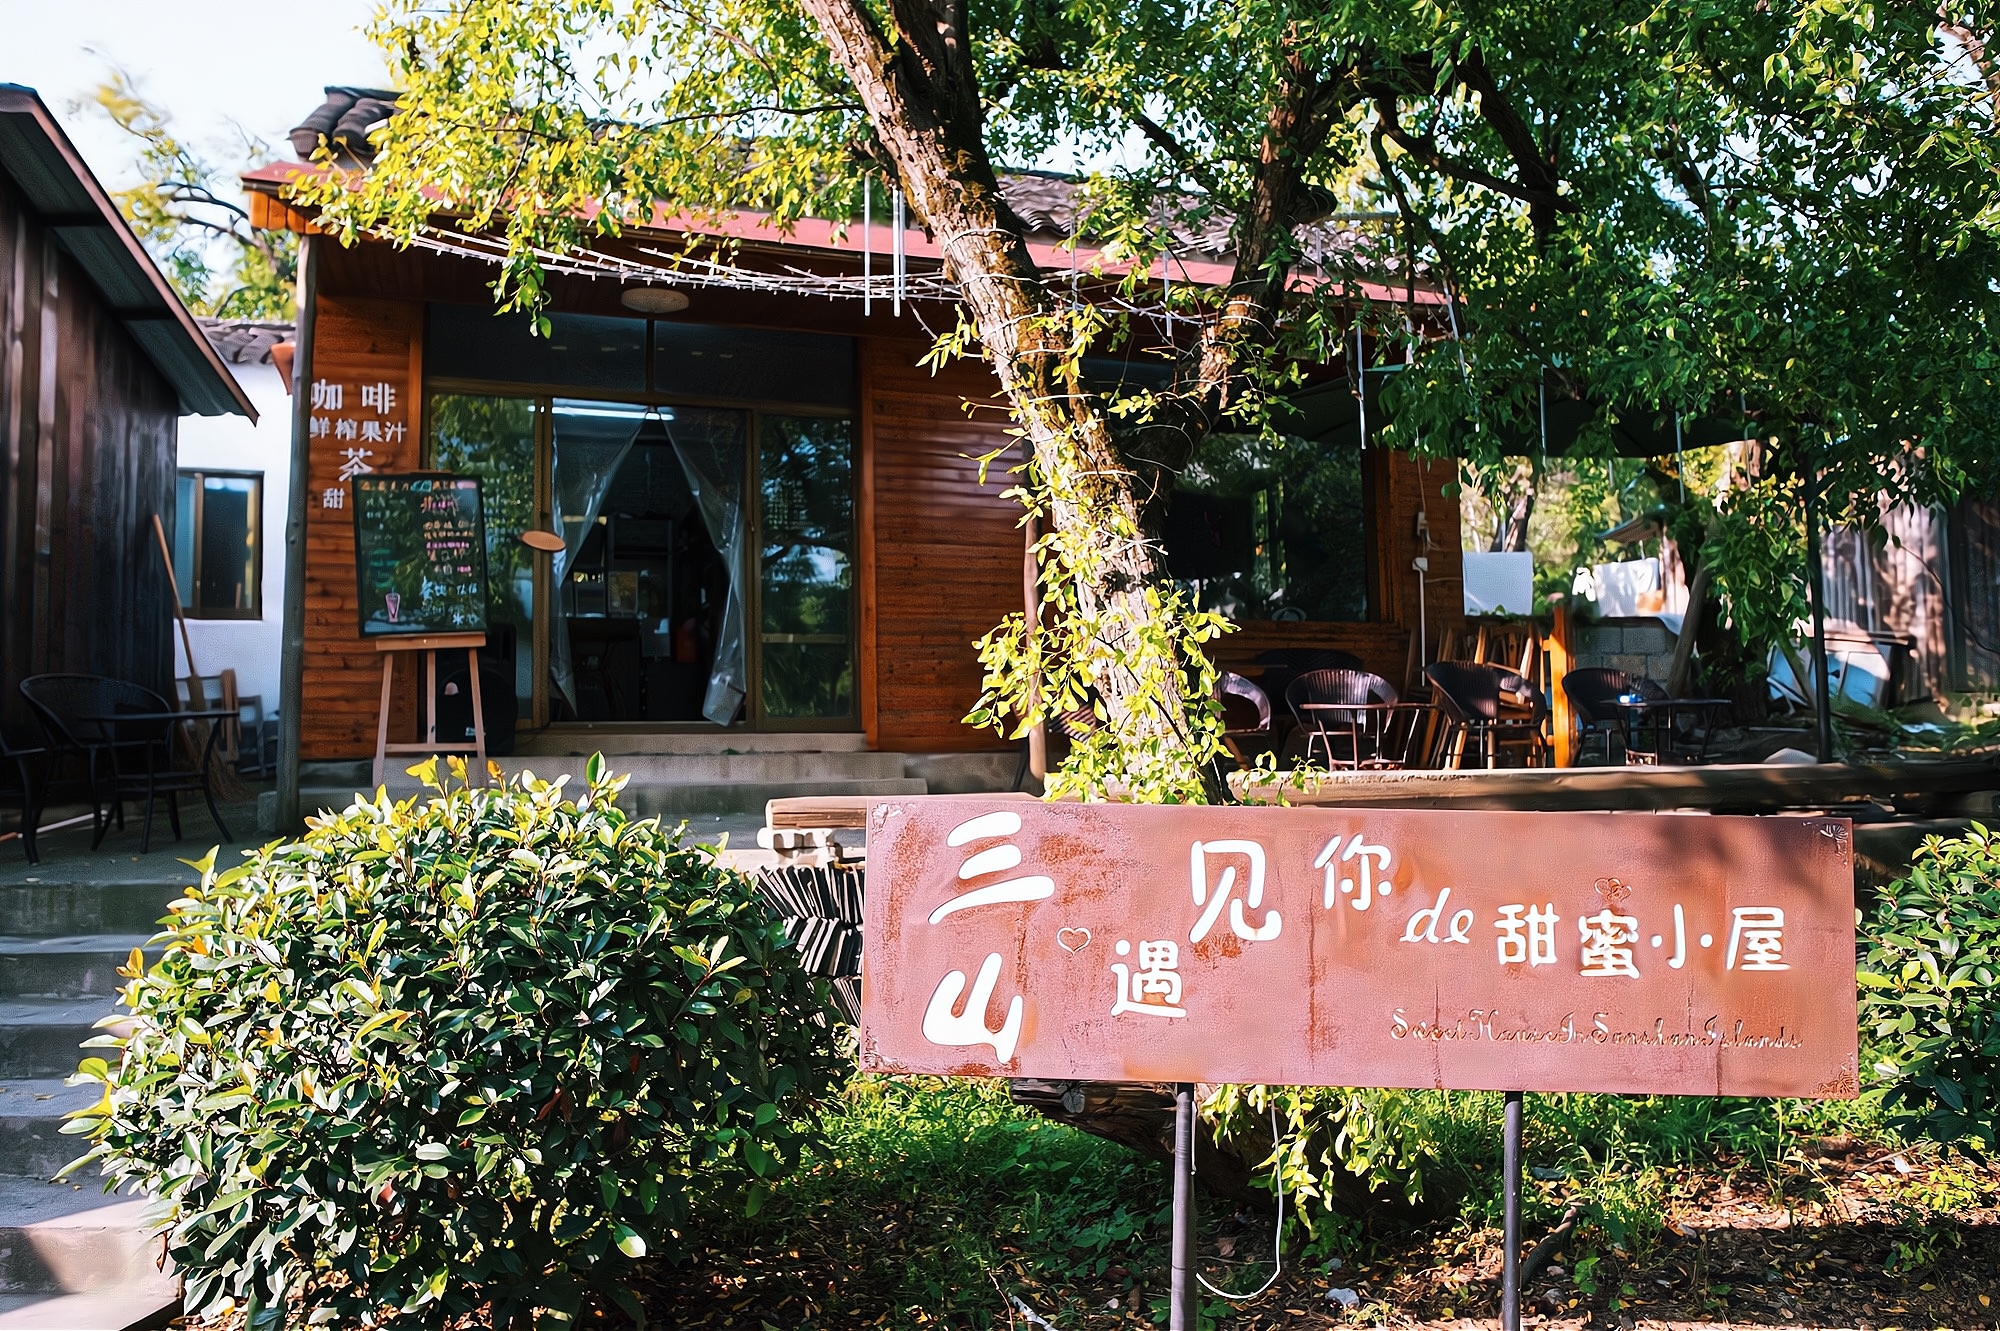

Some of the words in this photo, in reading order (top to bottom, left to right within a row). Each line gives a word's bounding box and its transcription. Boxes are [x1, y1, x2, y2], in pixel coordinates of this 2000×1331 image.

[311, 379, 396, 415] 咖啡
[310, 416, 407, 443] 鲜榨果汁
[339, 447, 373, 482] 茶
[1494, 903, 1791, 979] 甜蜜小屋
[1390, 1008, 1465, 1042] Sweet
